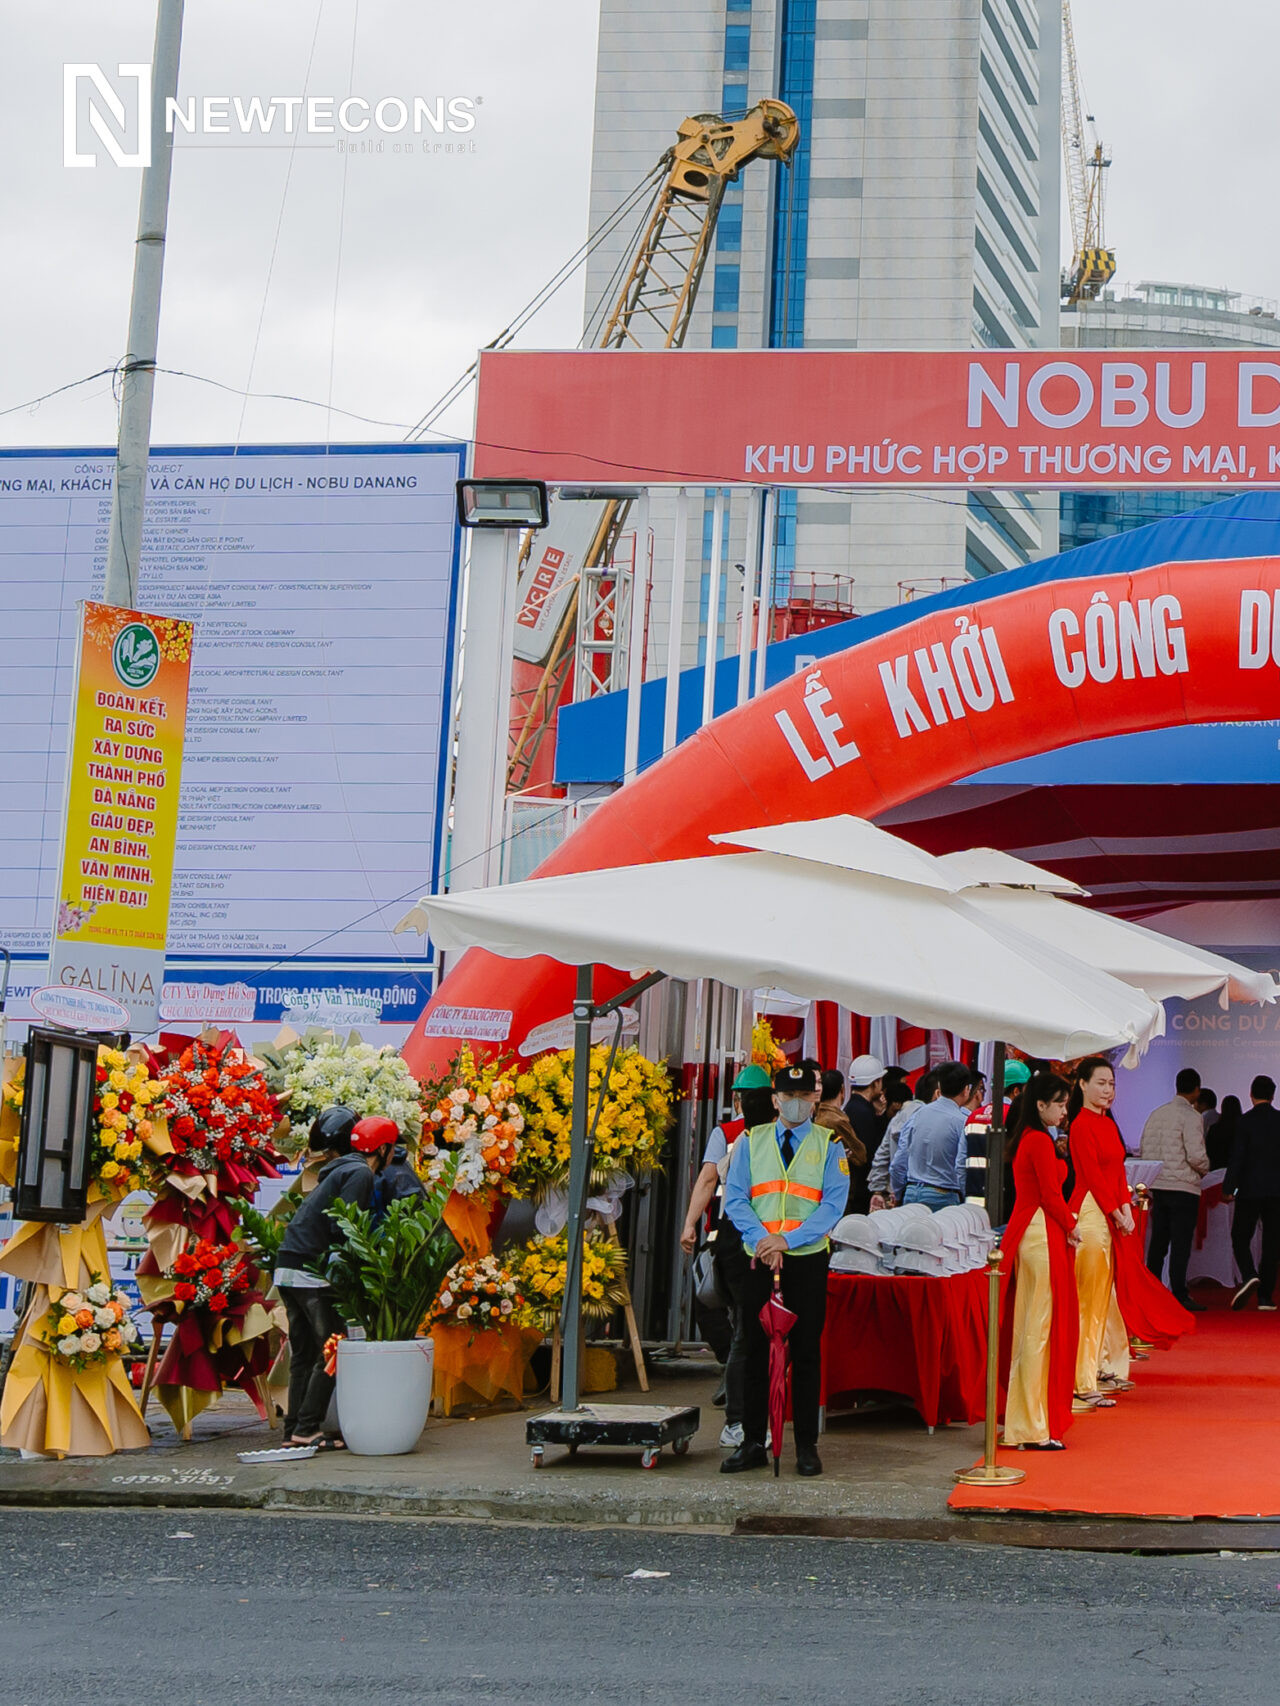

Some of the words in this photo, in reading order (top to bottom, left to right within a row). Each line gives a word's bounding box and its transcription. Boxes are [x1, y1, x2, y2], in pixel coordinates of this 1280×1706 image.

[966, 361, 1207, 429] NOBU
[74, 464, 104, 474] CÔNG
[743, 444, 815, 474] KHU
[826, 438, 922, 474] PHỨC
[933, 443, 1009, 482] HỢP
[1018, 443, 1172, 475] THƯƠNG
[1183, 445, 1257, 482] MẠI,
[26, 479, 56, 494] MẠI,
[60, 475, 112, 491] KHÁCH
[150, 475, 168, 490] VÀ
[174, 475, 205, 490] CĂN
[209, 474, 230, 493] HỘ
[235, 477, 256, 490] DU
[260, 477, 293, 492] LỊCH
[306, 476, 349, 489] NOBU
[353, 475, 417, 489] DANANG
[518, 548, 563, 625] VCRE
[774, 670, 861, 783] LỄ
[877, 615, 1016, 739] KHỞI
[1047, 590, 1190, 689] CÔNG
[97, 690, 135, 712] ĐOÀN
[138, 696, 167, 718] KẾT,
[104, 716, 123, 734] RA
[127, 719, 155, 739] SỨC
[93, 737, 121, 757] XÂY
[124, 745, 163, 765] DỰNG
[88, 762, 133, 784] THÀNH
[136, 769, 167, 789] PHỐ
[93, 787, 113, 804] ĐÀ
[116, 789, 156, 811] NẴNG
[90, 812, 124, 831] GIÀU
[126, 819, 156, 837] ĐẸP,
[89, 837, 110, 854] AN
[81, 858, 110, 878] VĂN
[112, 864, 155, 884] MINH,
[83, 884, 116, 905] HIỆN
[119, 890, 149, 908] ĐẠI!
[281, 990, 309, 1010] Công
[311, 992, 322, 1009] ty
[383, 984, 417, 1008] ĐỘNG
[1171, 1011, 1232, 1031] CÔNG
[1238, 1012, 1270, 1033] DỰ
[1151, 1037, 1230, 1047] ommencement
